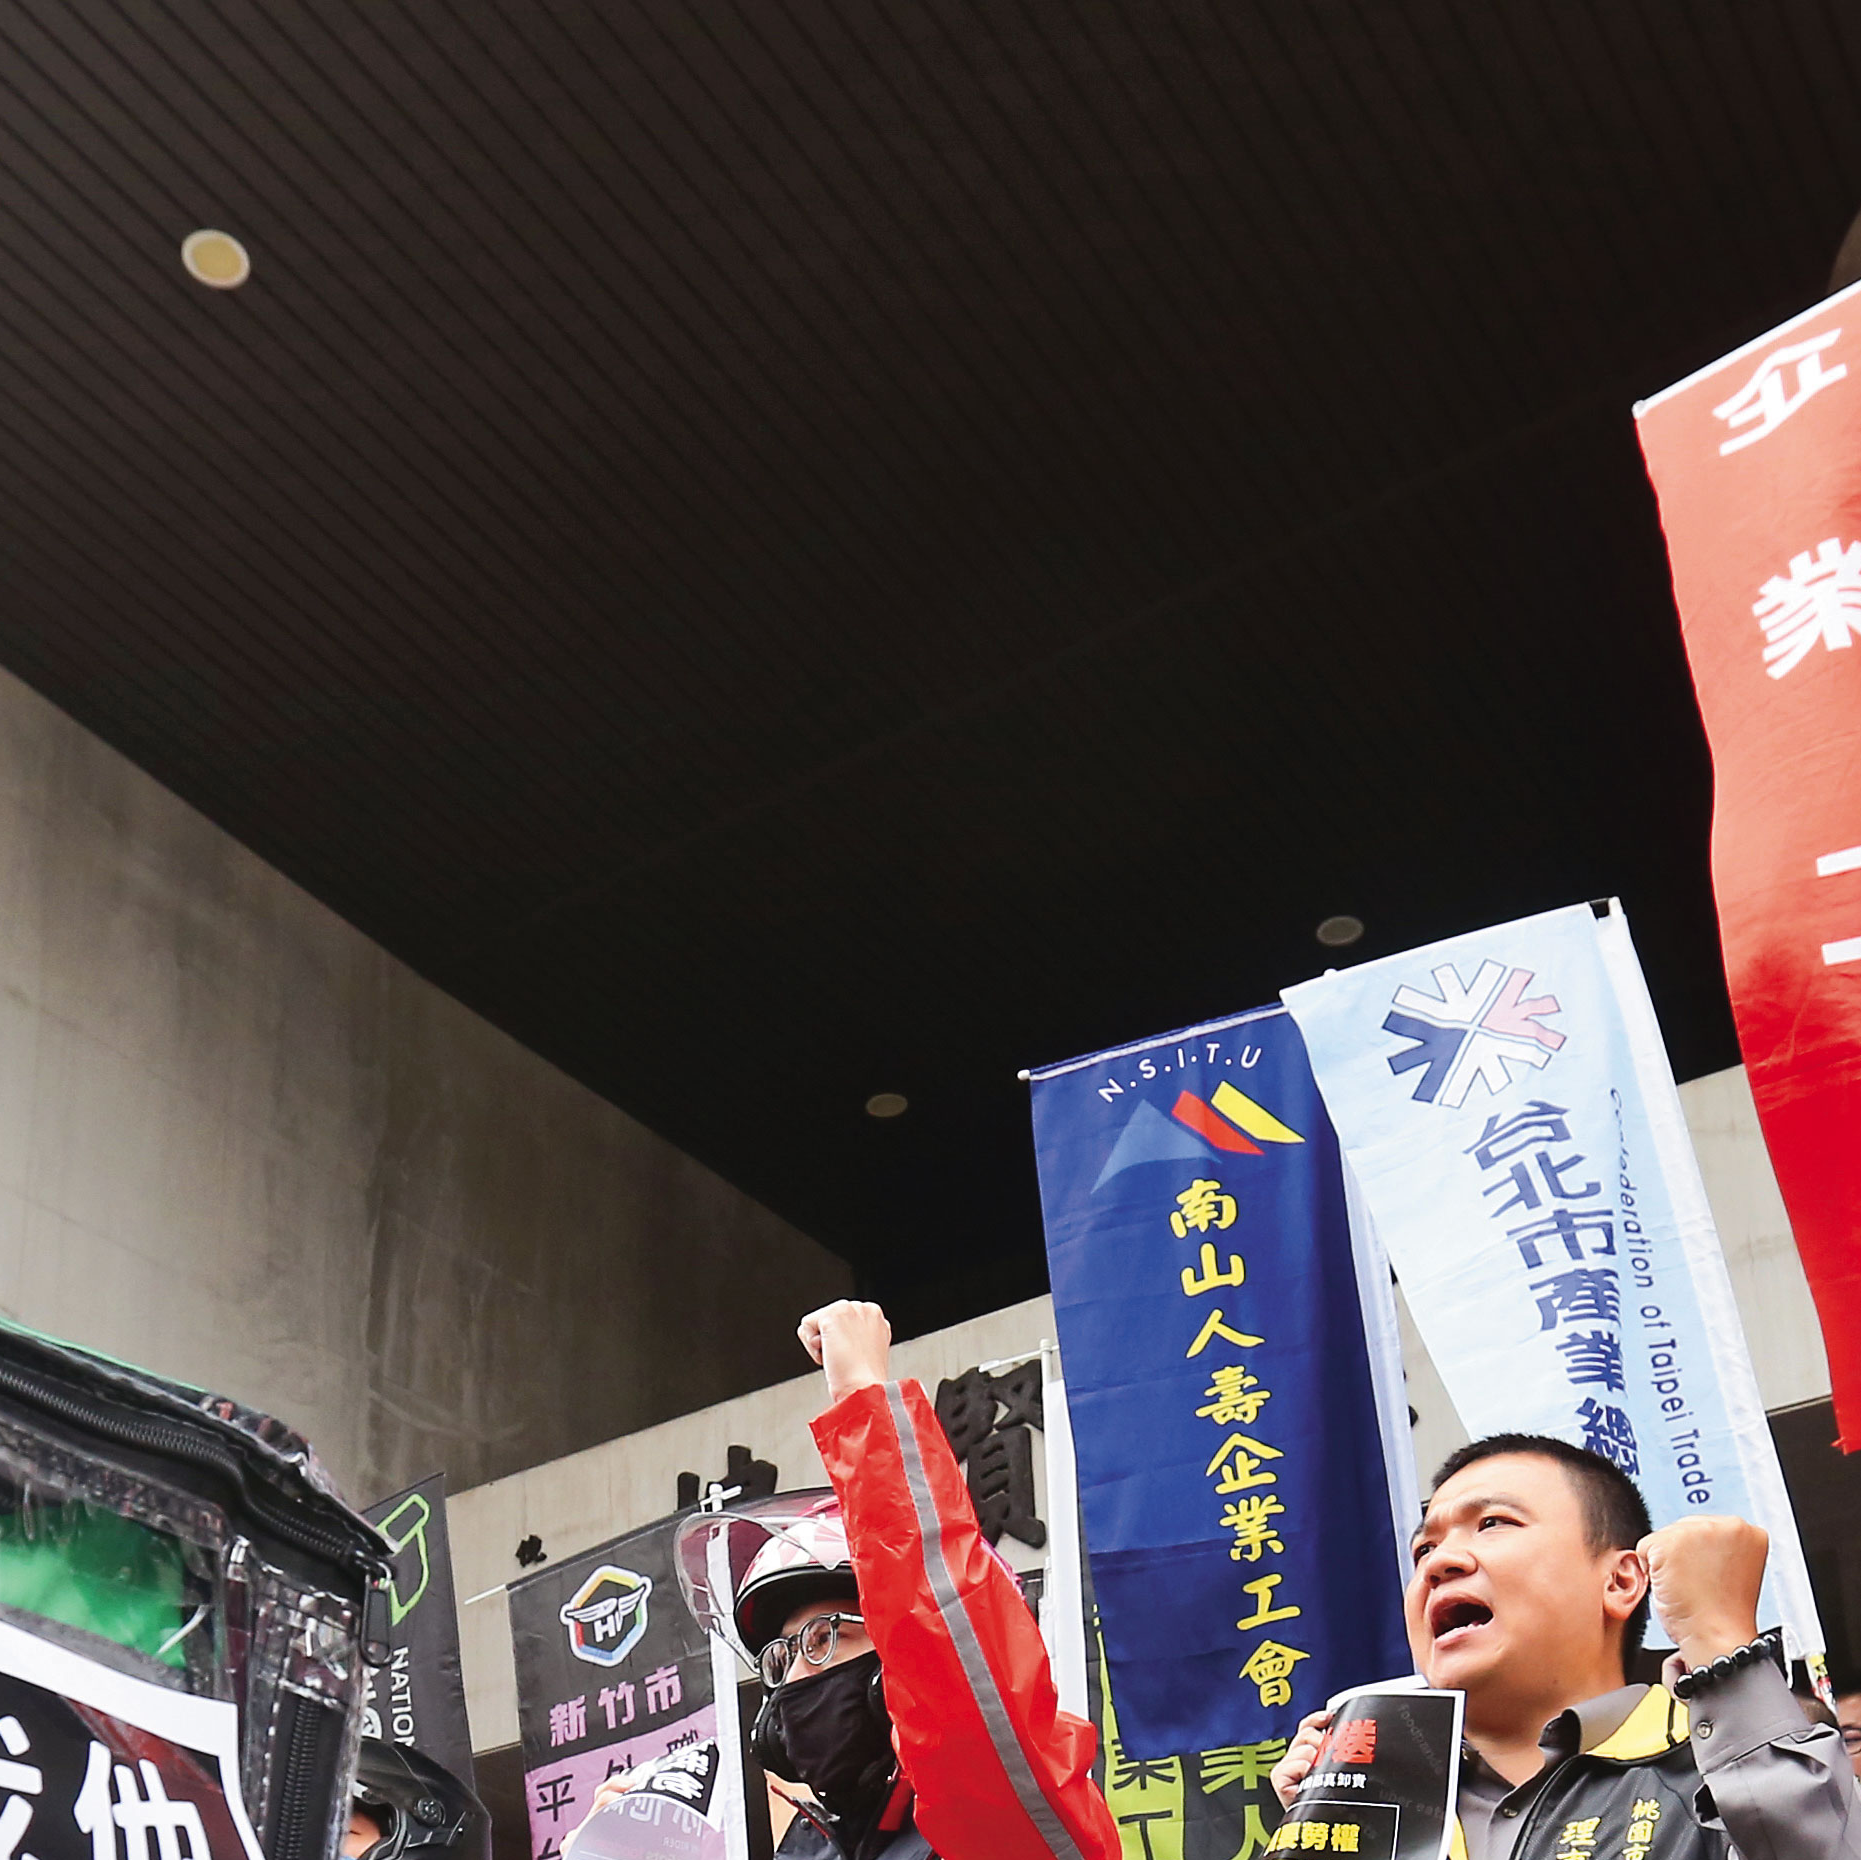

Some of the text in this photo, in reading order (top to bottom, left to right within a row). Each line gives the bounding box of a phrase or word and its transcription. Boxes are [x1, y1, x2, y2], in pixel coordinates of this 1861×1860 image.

[1640, 1304, 1672, 1330] of
[1648, 1337, 1694, 1423] Taipei
[1169, 1178, 1311, 1708] 南山人壽企業工會
[1670, 1429, 1715, 1505] Trade
[549, 1664, 683, 1748] 新竹市
